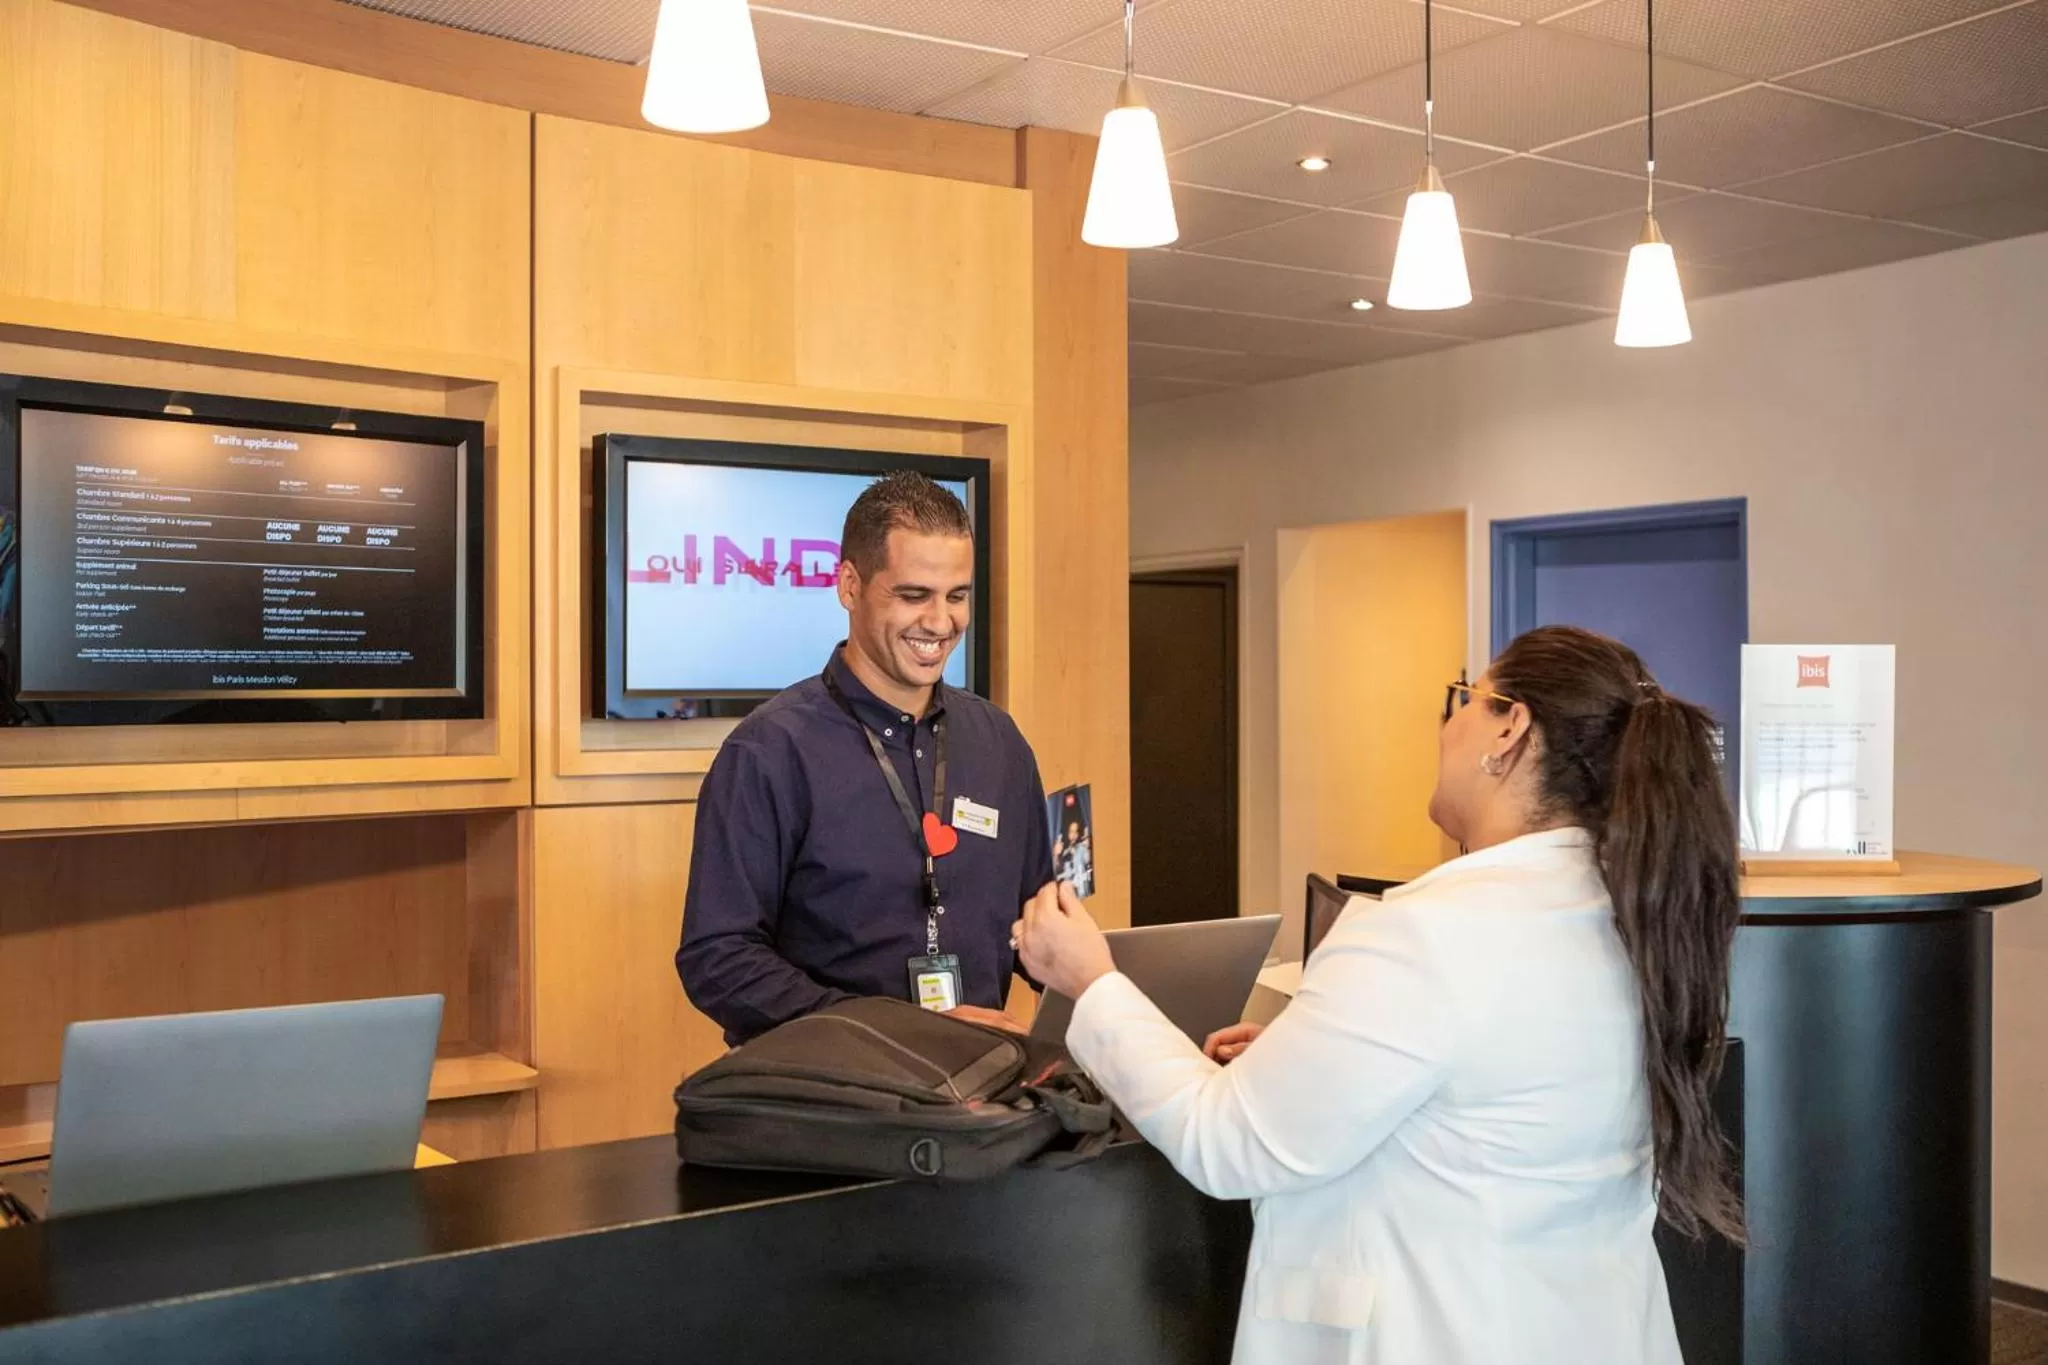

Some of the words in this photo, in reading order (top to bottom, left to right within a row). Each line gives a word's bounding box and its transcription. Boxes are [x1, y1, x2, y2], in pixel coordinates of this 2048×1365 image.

[212, 434, 242, 447] Tarifs
[243, 437, 299, 451] applicables
[76, 488, 111, 498] Chambre
[112, 490, 145, 500] Standard
[76, 512, 110, 522] Chambre
[111, 514, 166, 525] Communicante
[266, 521, 300, 531] AUCUNE
[317, 524, 350, 534] AUCUNE
[266, 532, 292, 541] DISPO
[366, 527, 398, 537] AUCUNE
[76, 537, 110, 546] Chambre
[112, 539, 151, 548] Supérieure
[316, 535, 342, 544] DISPO
[365, 537, 391, 546] DISPO
[76, 581, 100, 591] Parking
[1801, 664, 1825, 677] ibis
[226, 675, 245, 684] Paris
